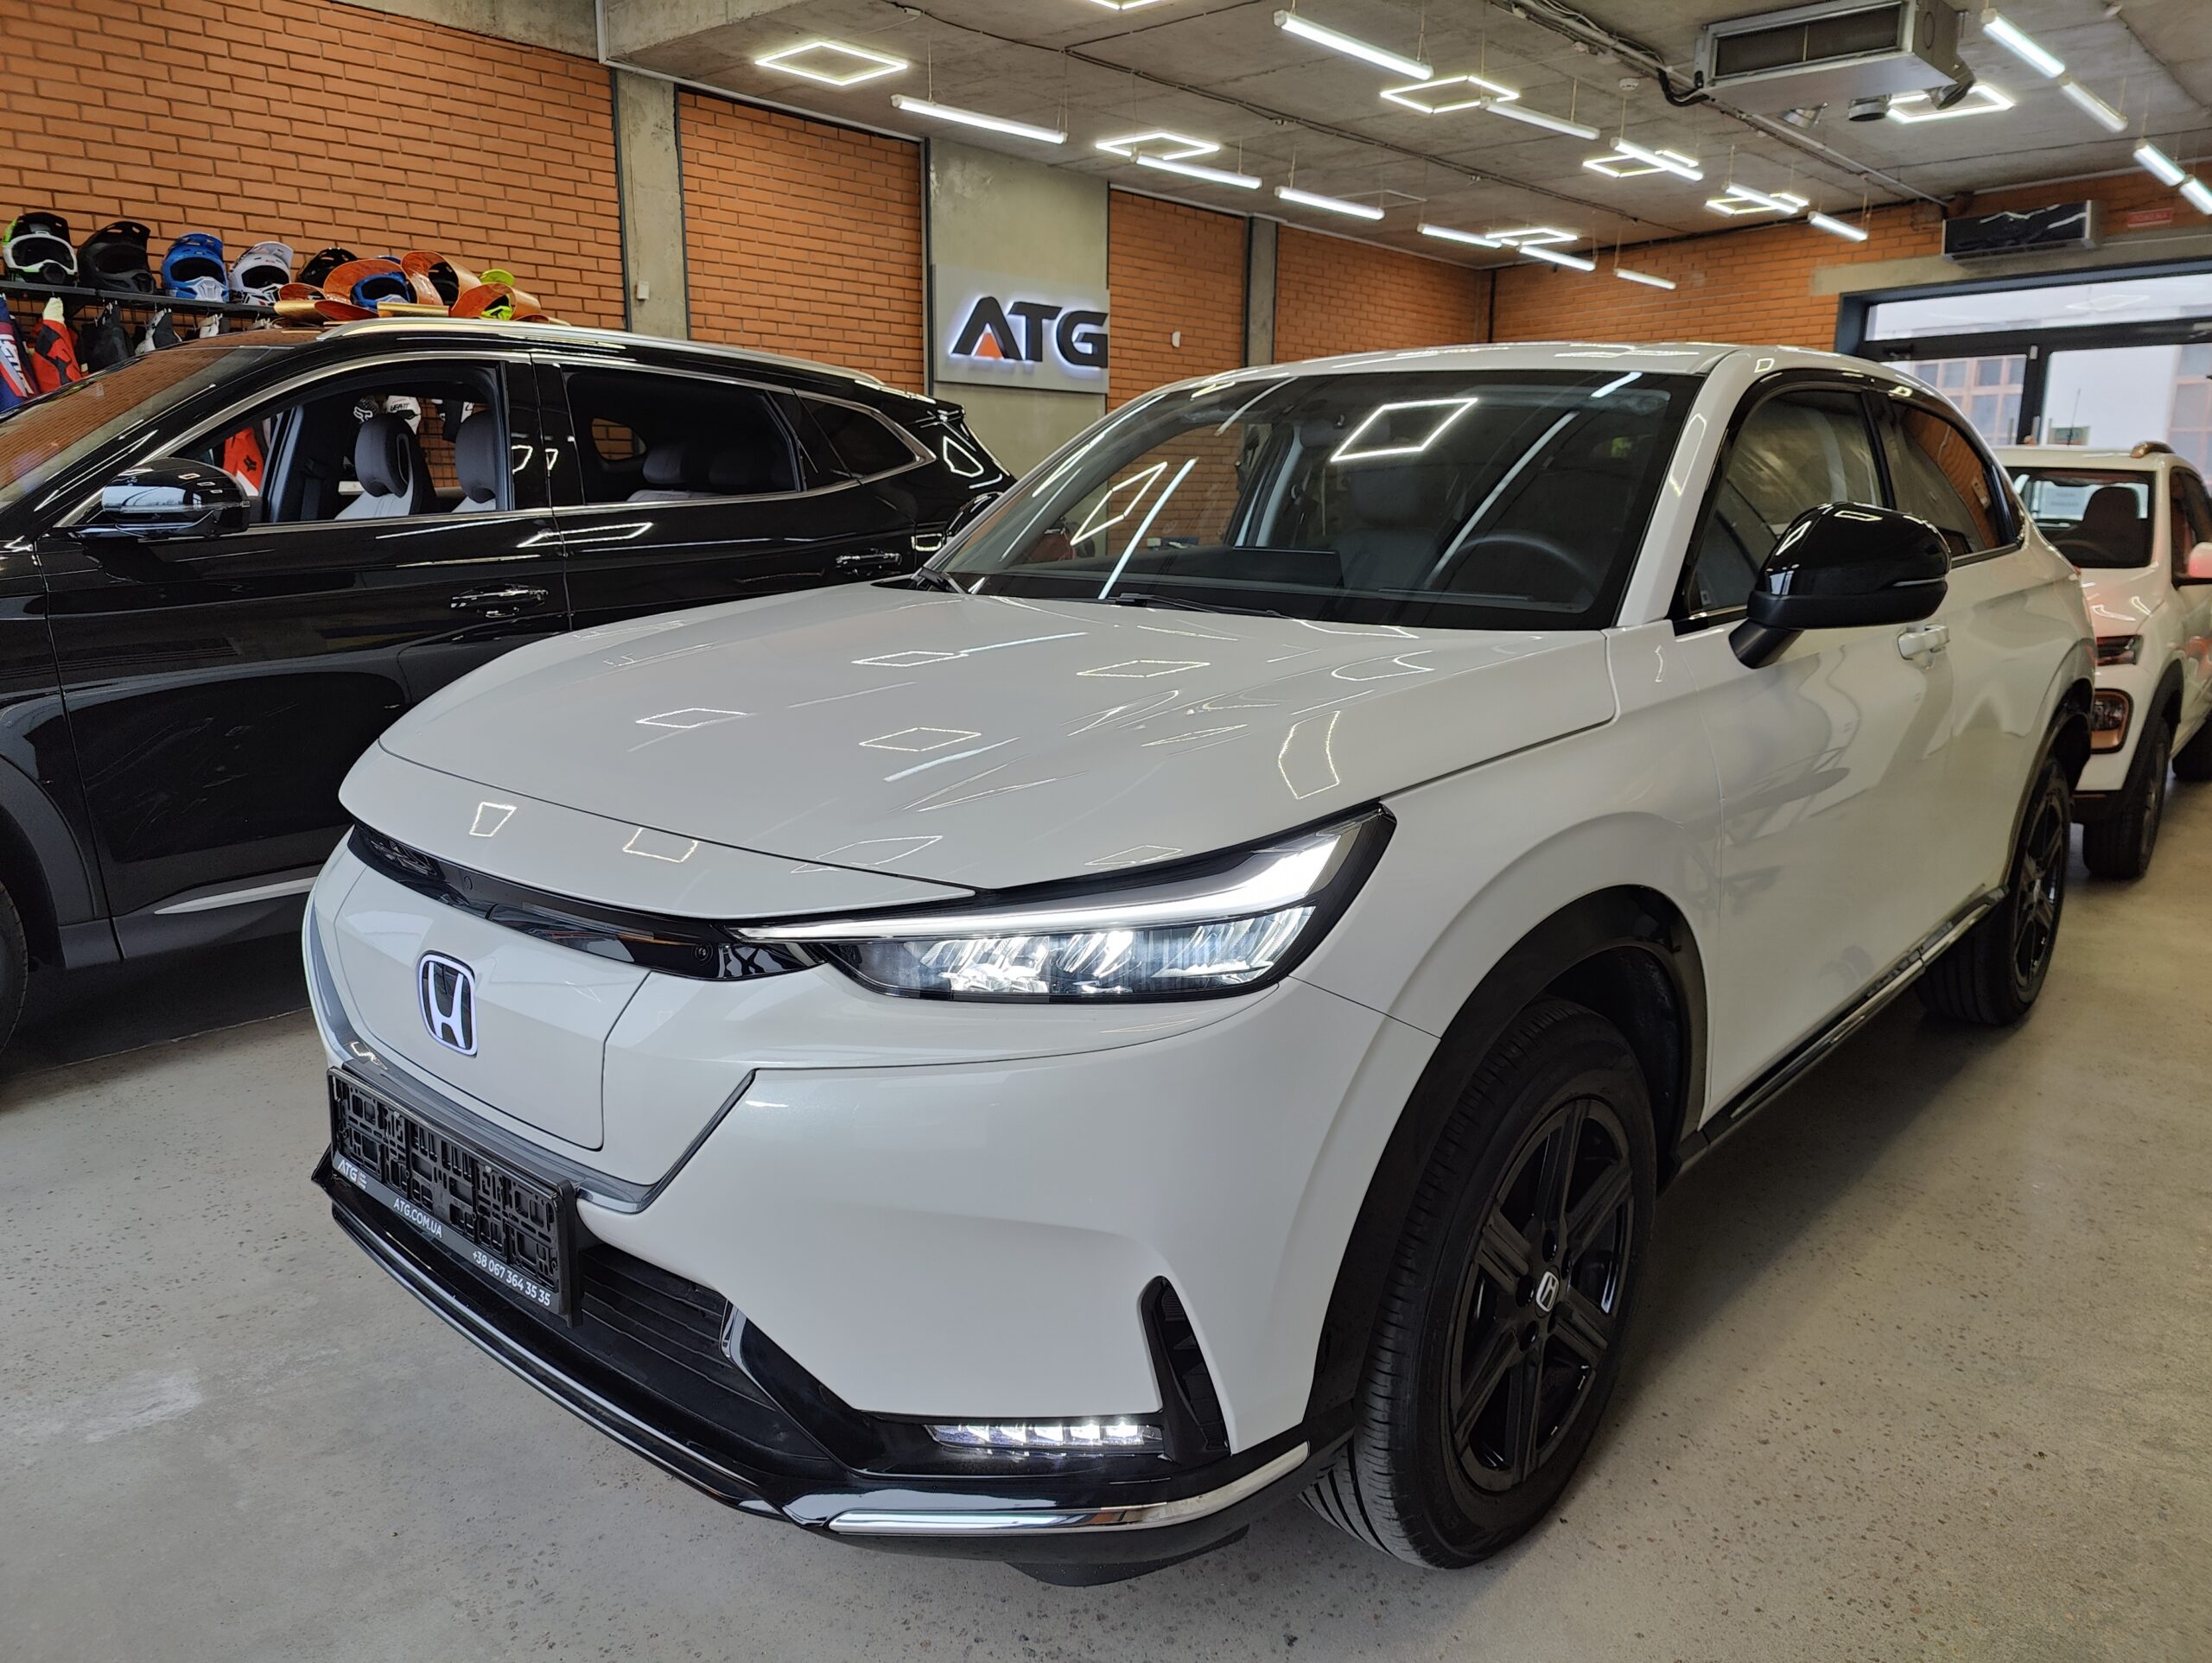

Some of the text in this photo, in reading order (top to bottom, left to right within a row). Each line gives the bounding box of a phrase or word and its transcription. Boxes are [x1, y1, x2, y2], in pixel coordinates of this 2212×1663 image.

[951, 295, 1109, 369] ATG
[337, 1158, 359, 1183] ATG
[393, 1197, 442, 1239] ATG.COM.UA
[472, 1250, 551, 1306] +38 067 364 35 35
